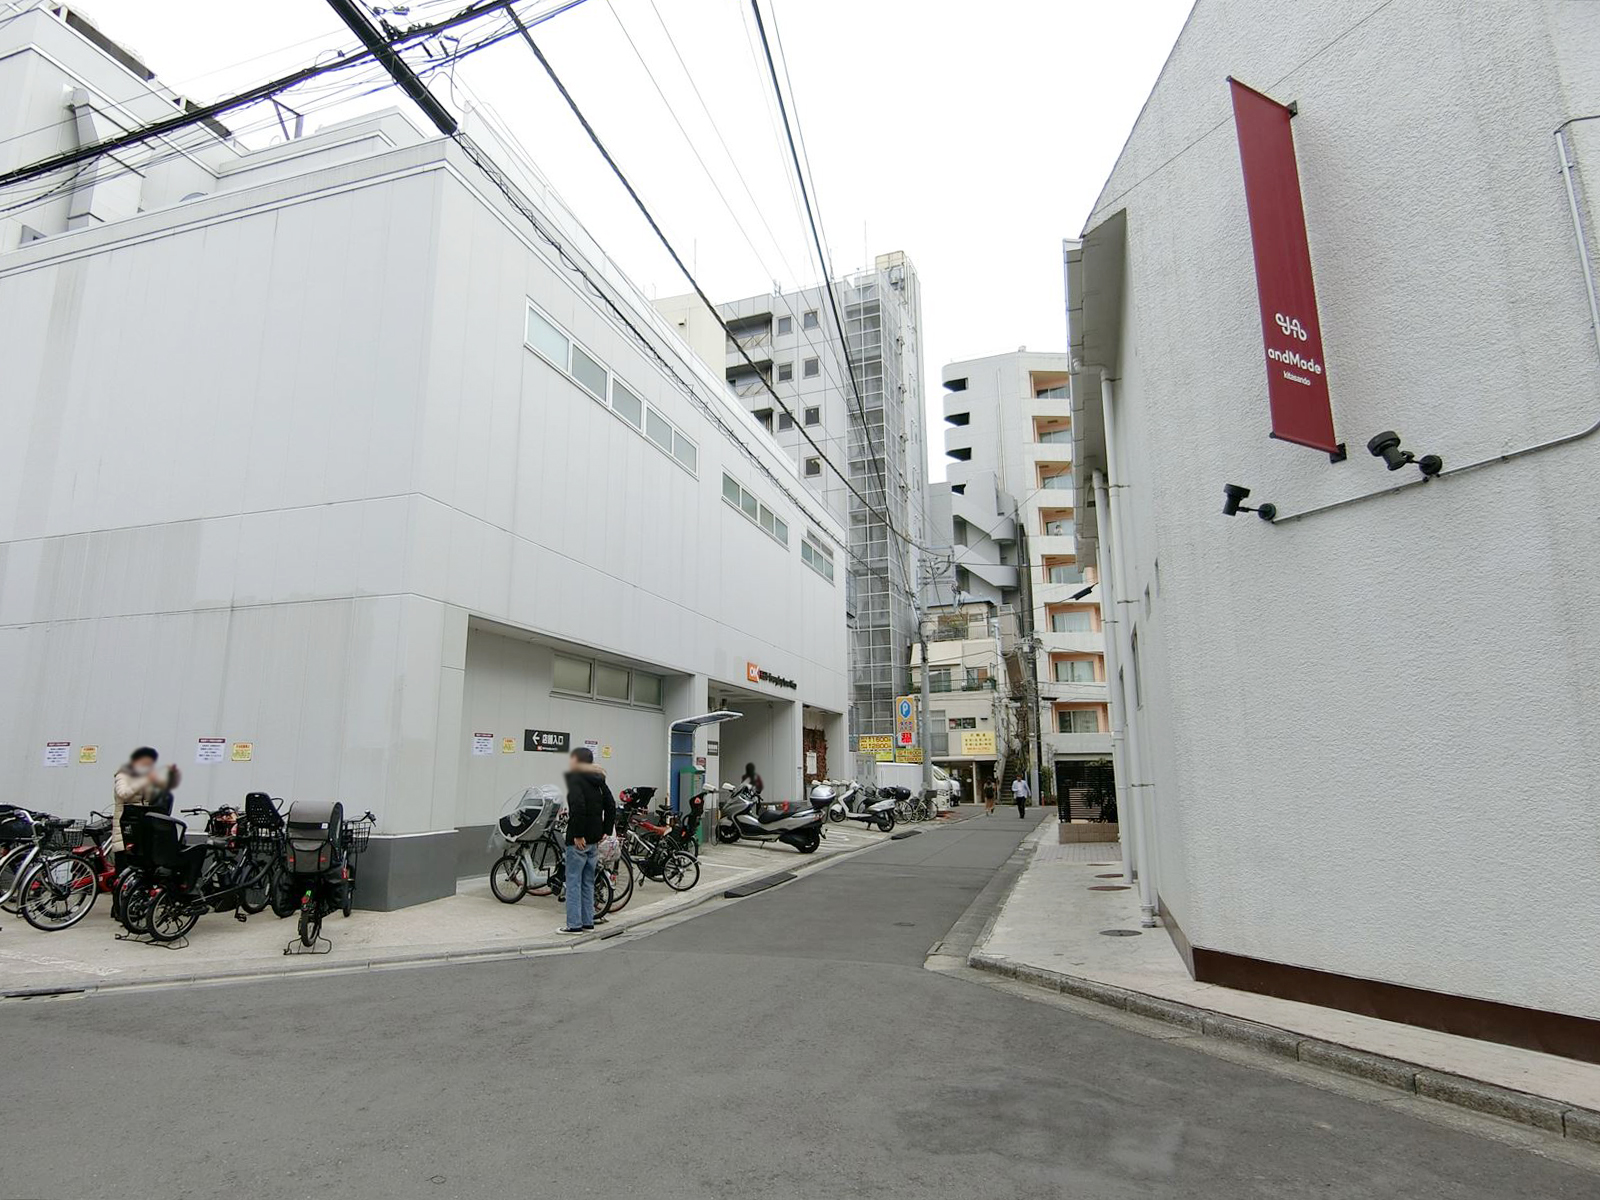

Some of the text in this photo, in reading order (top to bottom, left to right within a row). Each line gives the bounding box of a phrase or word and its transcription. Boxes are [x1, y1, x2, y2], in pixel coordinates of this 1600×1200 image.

[1268, 348, 1321, 374] andMade
[542, 733, 564, 745] 店舗入口
